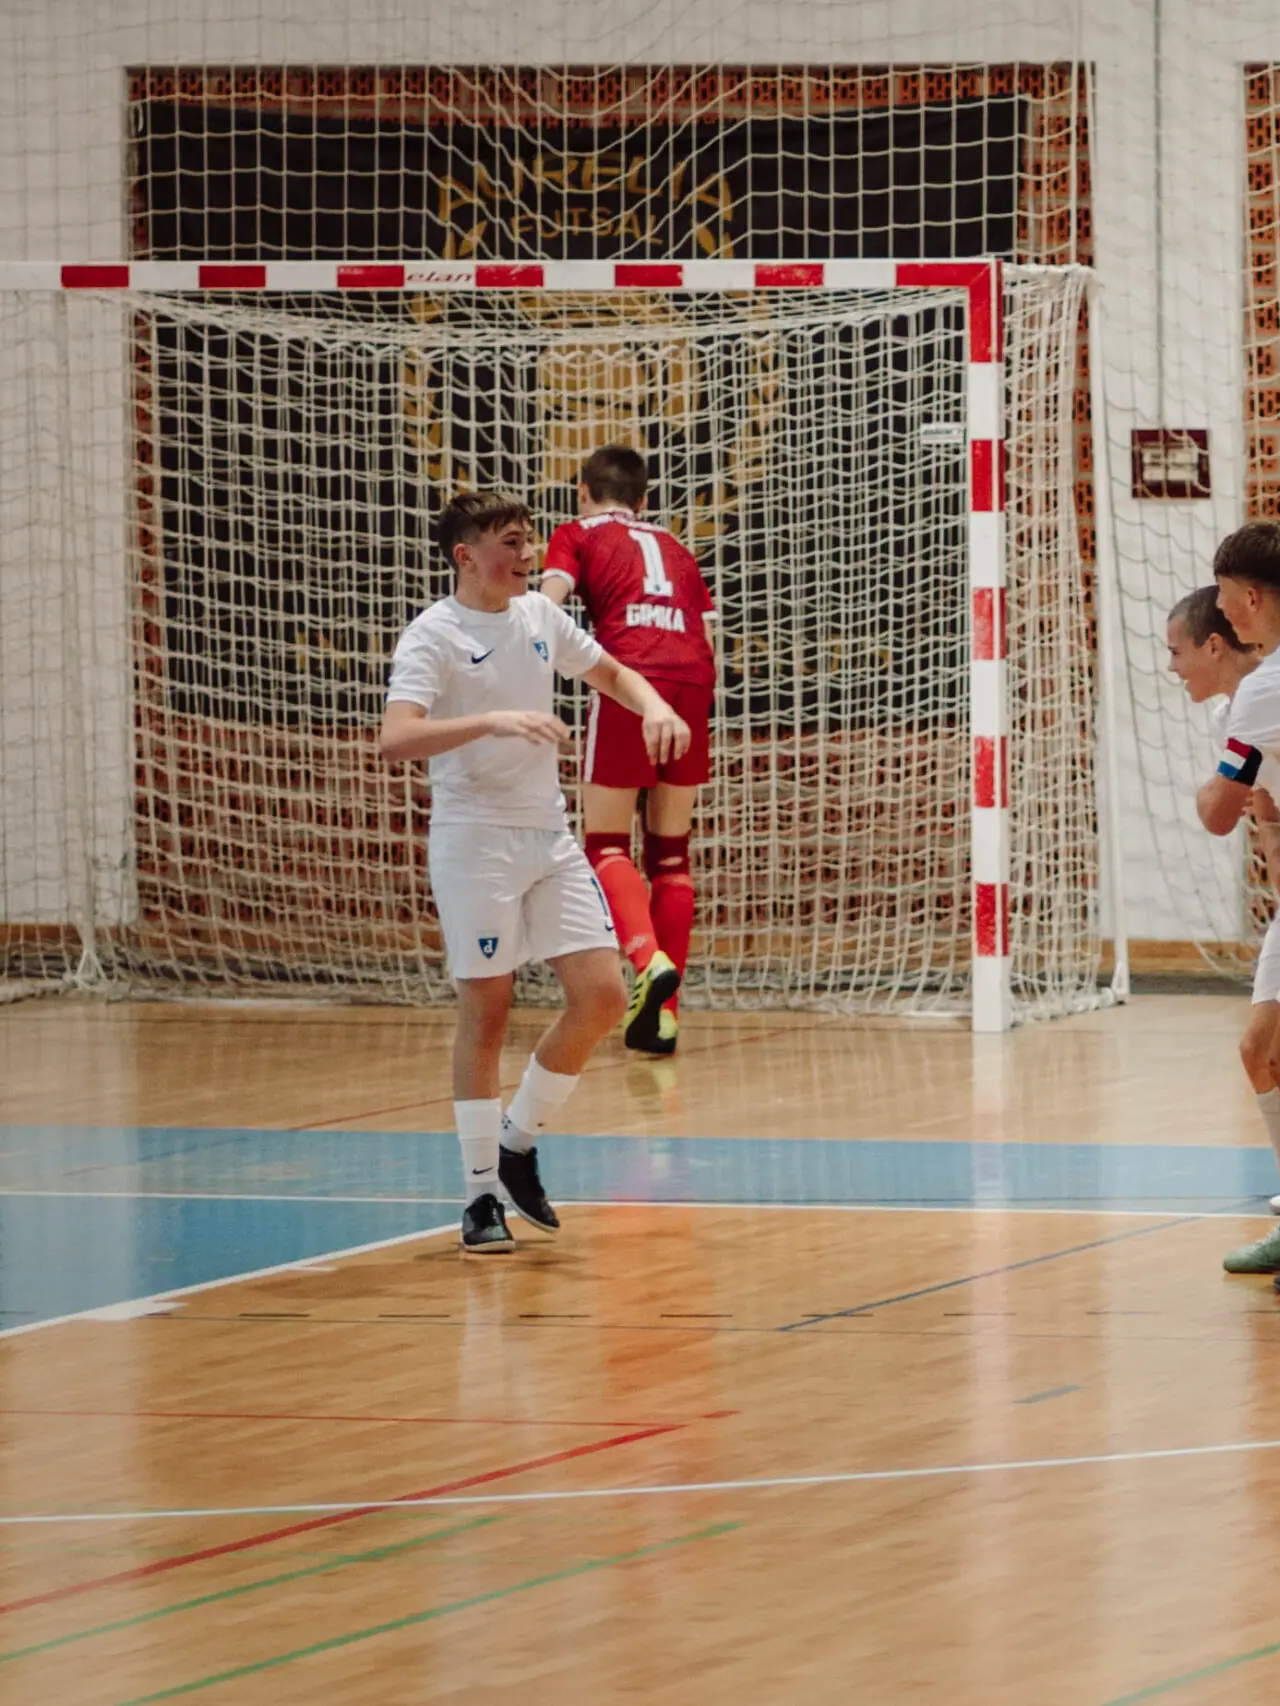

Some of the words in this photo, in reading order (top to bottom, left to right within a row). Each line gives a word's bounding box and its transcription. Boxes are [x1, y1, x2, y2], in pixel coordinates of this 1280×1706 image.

[437, 154, 733, 223] AURELIA
[510, 207, 664, 245] FUTSAL
[406, 270, 473, 283] elan
[627, 529, 674, 597] 1
